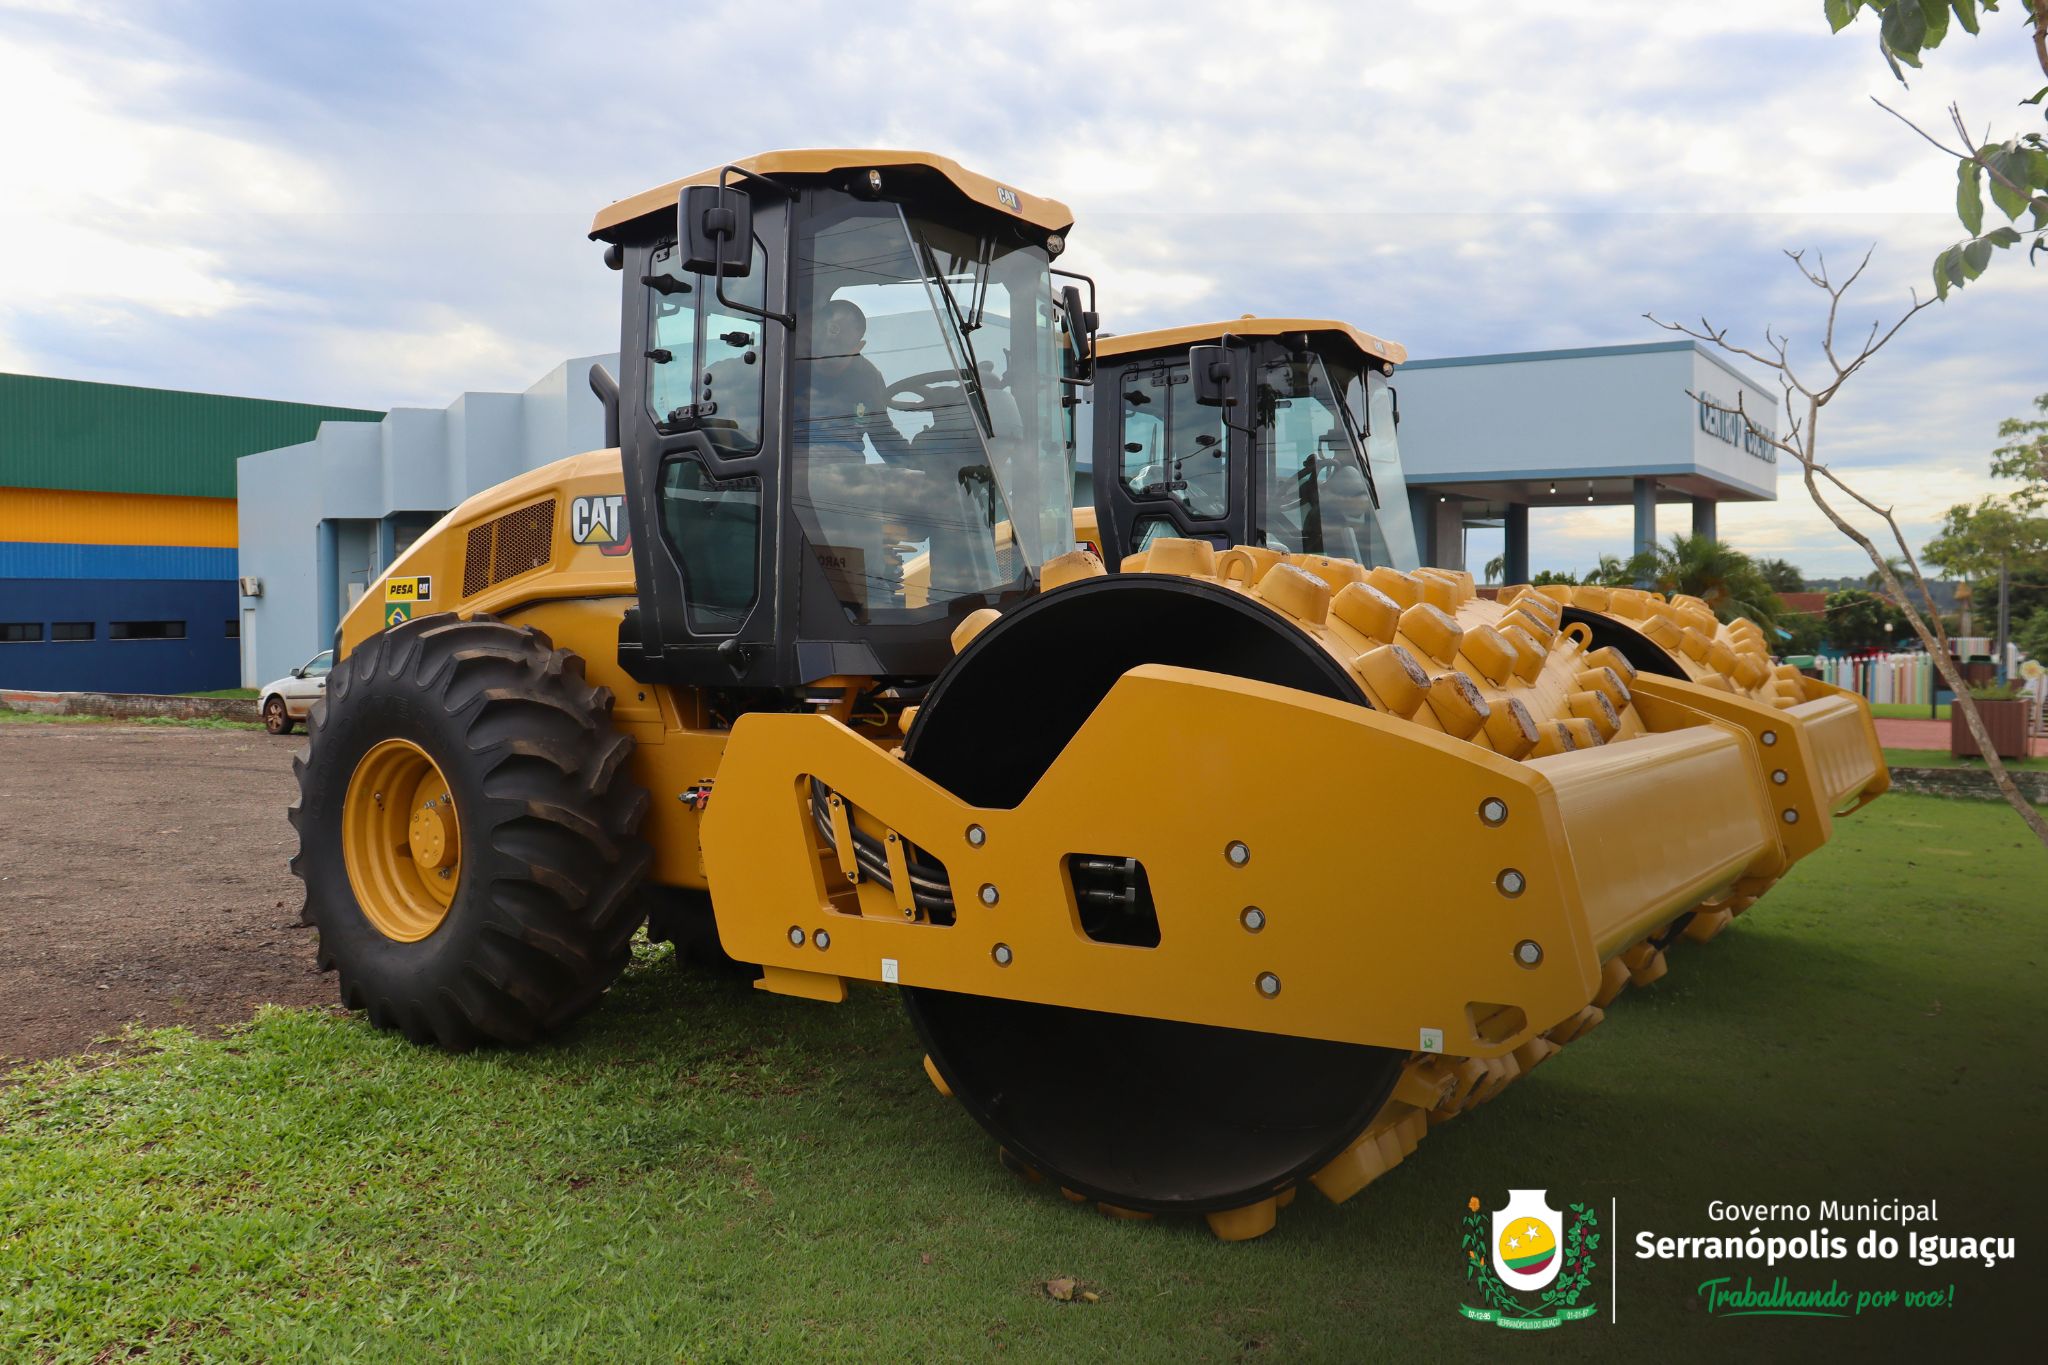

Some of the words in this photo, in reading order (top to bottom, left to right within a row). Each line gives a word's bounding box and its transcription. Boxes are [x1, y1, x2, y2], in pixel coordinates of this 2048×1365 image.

[997, 187, 1017, 208] CAT
[572, 496, 623, 544] CAT
[390, 584, 413, 595] PESA
